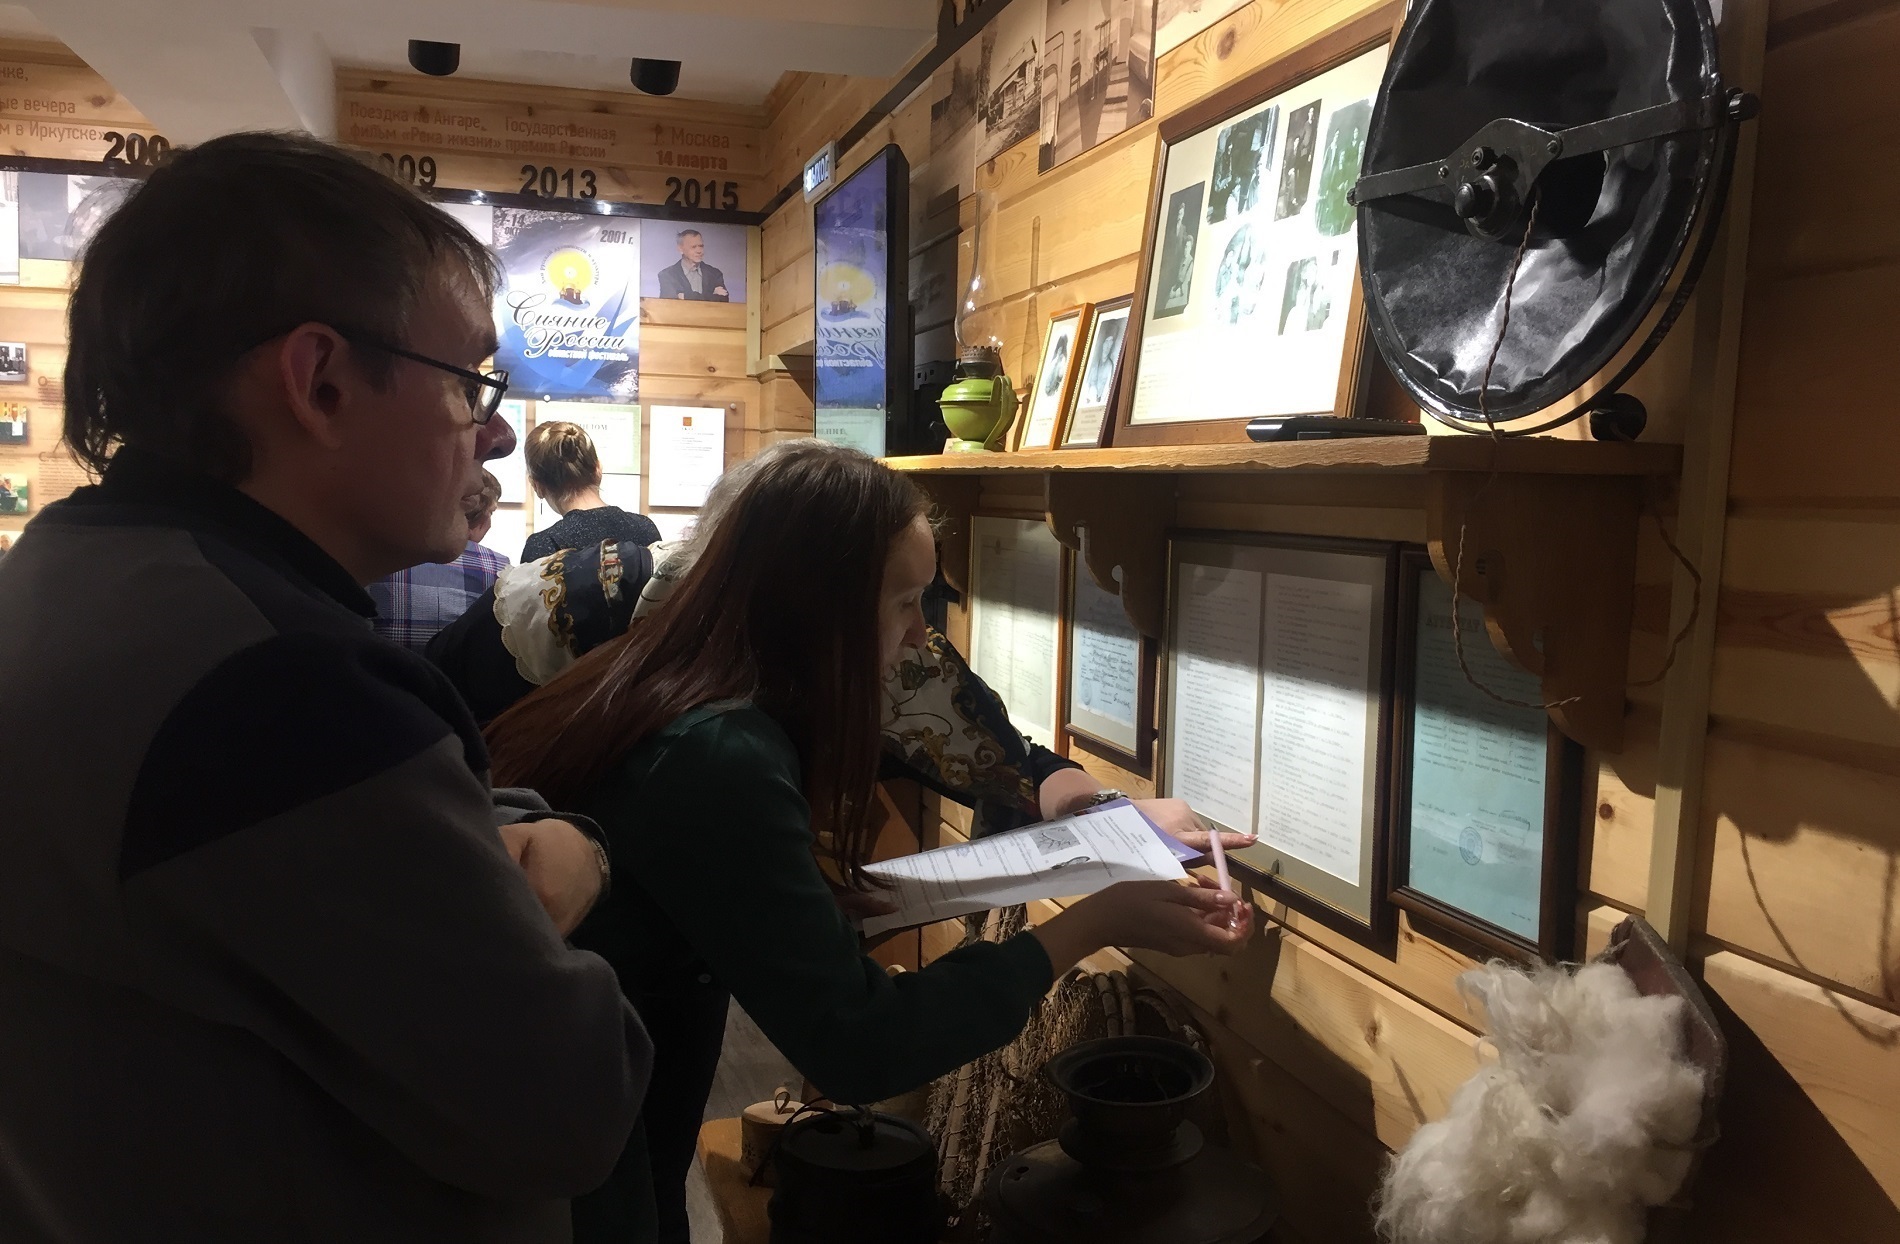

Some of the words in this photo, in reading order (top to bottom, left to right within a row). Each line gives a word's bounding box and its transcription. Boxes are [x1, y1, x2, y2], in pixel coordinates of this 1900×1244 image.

[24, 98, 76, 117] вечера
[350, 101, 409, 122] Поездка
[434, 111, 488, 131] Ангаре,
[16, 124, 24, 136] в
[30, 121, 104, 142] Иркутске»
[350, 123, 397, 140] фильм
[402, 127, 443, 144] «Река
[447, 133, 502, 149] жизни»
[505, 116, 617, 142] Государственная
[671, 127, 730, 149] Москва
[103, 131, 170, 164] 200
[505, 138, 556, 154] премия
[560, 140, 607, 159] России
[656, 149, 674, 167] 14
[677, 152, 728, 170] марта
[379, 153, 436, 188] 09
[520, 164, 598, 198] 2013
[665, 176, 739, 209] 2015
[600, 229, 627, 244] 2001
[628, 236, 634, 245] г.
[506, 290, 609, 330] Сияние
[523, 326, 626, 358] России
